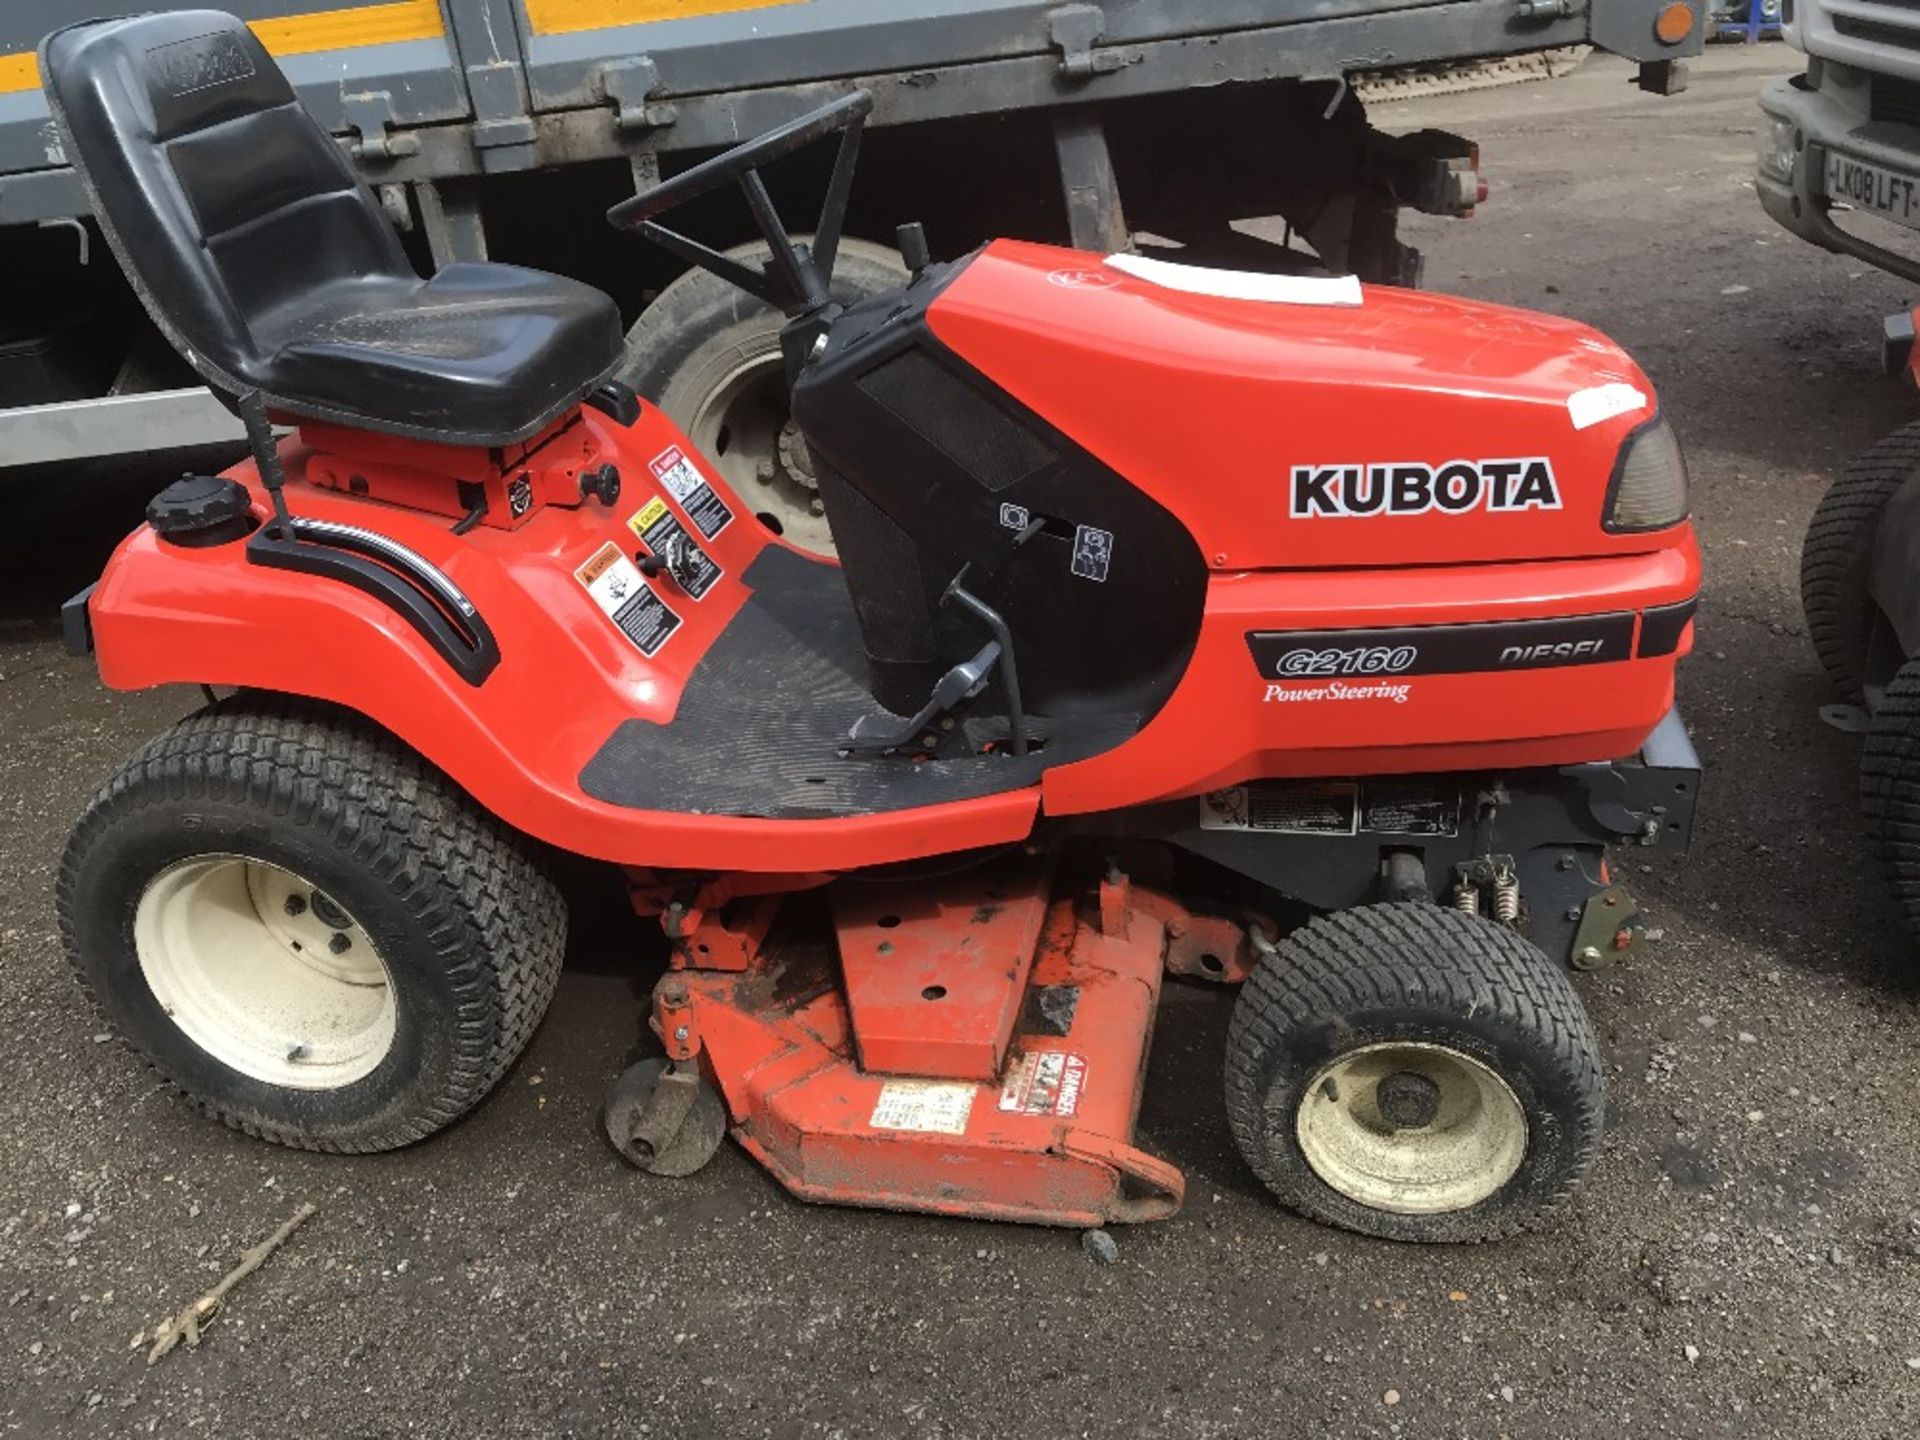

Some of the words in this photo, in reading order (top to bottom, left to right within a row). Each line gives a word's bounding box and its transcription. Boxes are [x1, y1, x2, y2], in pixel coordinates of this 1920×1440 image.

[1835, 158, 1873, 204] LK08
[1877, 173, 1916, 217] LFT
[1289, 457, 1563, 519] KUBOTA
[1276, 646, 1418, 676] G2160
[1057, 1068, 1081, 1116] DANGER
